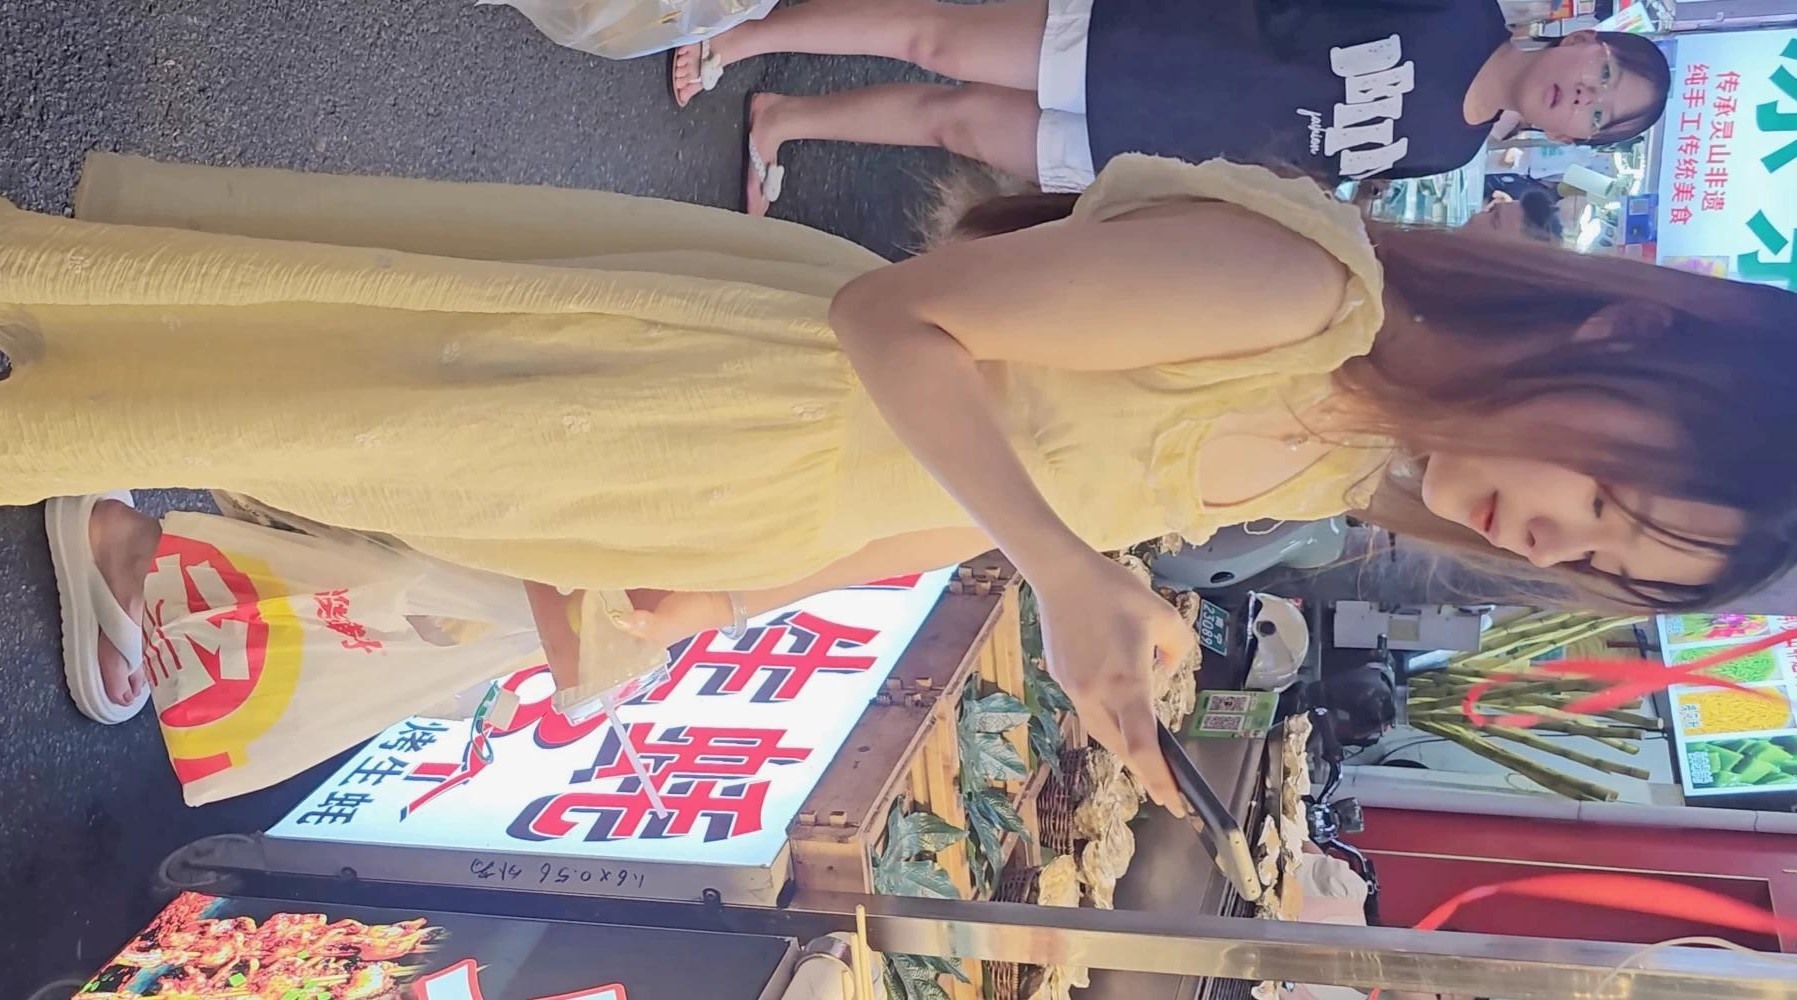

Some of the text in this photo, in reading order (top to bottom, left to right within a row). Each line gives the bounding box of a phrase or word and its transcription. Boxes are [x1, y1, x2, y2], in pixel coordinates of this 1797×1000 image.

[1669, 63, 1710, 226] 纯手工传统美食
[1701, 70, 1741, 212] 传承灵山非遗
[1201, 604, 1216, 645] 23089
[509, 573, 922, 842] 生蚝
